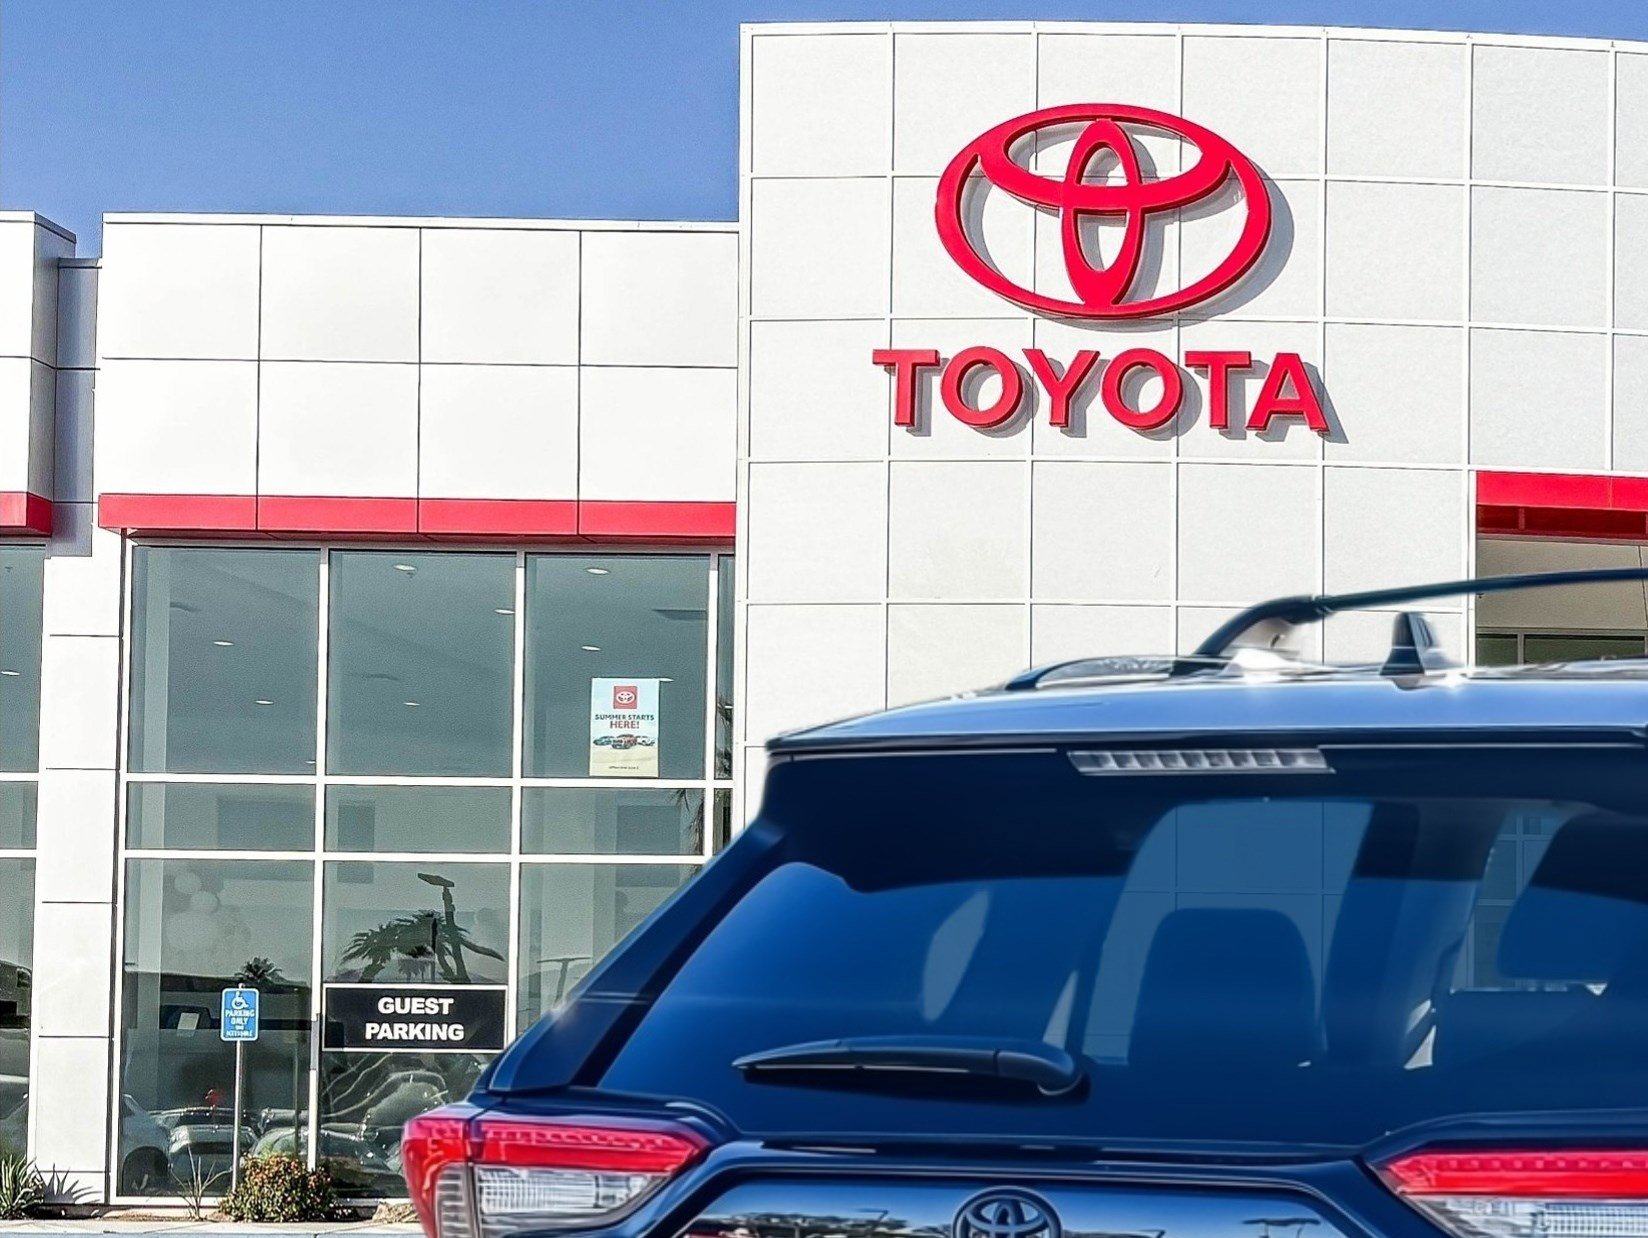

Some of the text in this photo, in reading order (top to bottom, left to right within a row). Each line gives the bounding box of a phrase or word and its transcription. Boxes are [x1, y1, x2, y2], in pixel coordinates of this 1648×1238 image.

[872, 346, 1328, 432] TOYOTA
[609, 720, 640, 729] HERE!
[377, 996, 454, 1015] GUEST
[225, 1009, 255, 1018] PARKING
[230, 1017, 249, 1025] ONLY
[365, 1022, 464, 1041] PARKING
